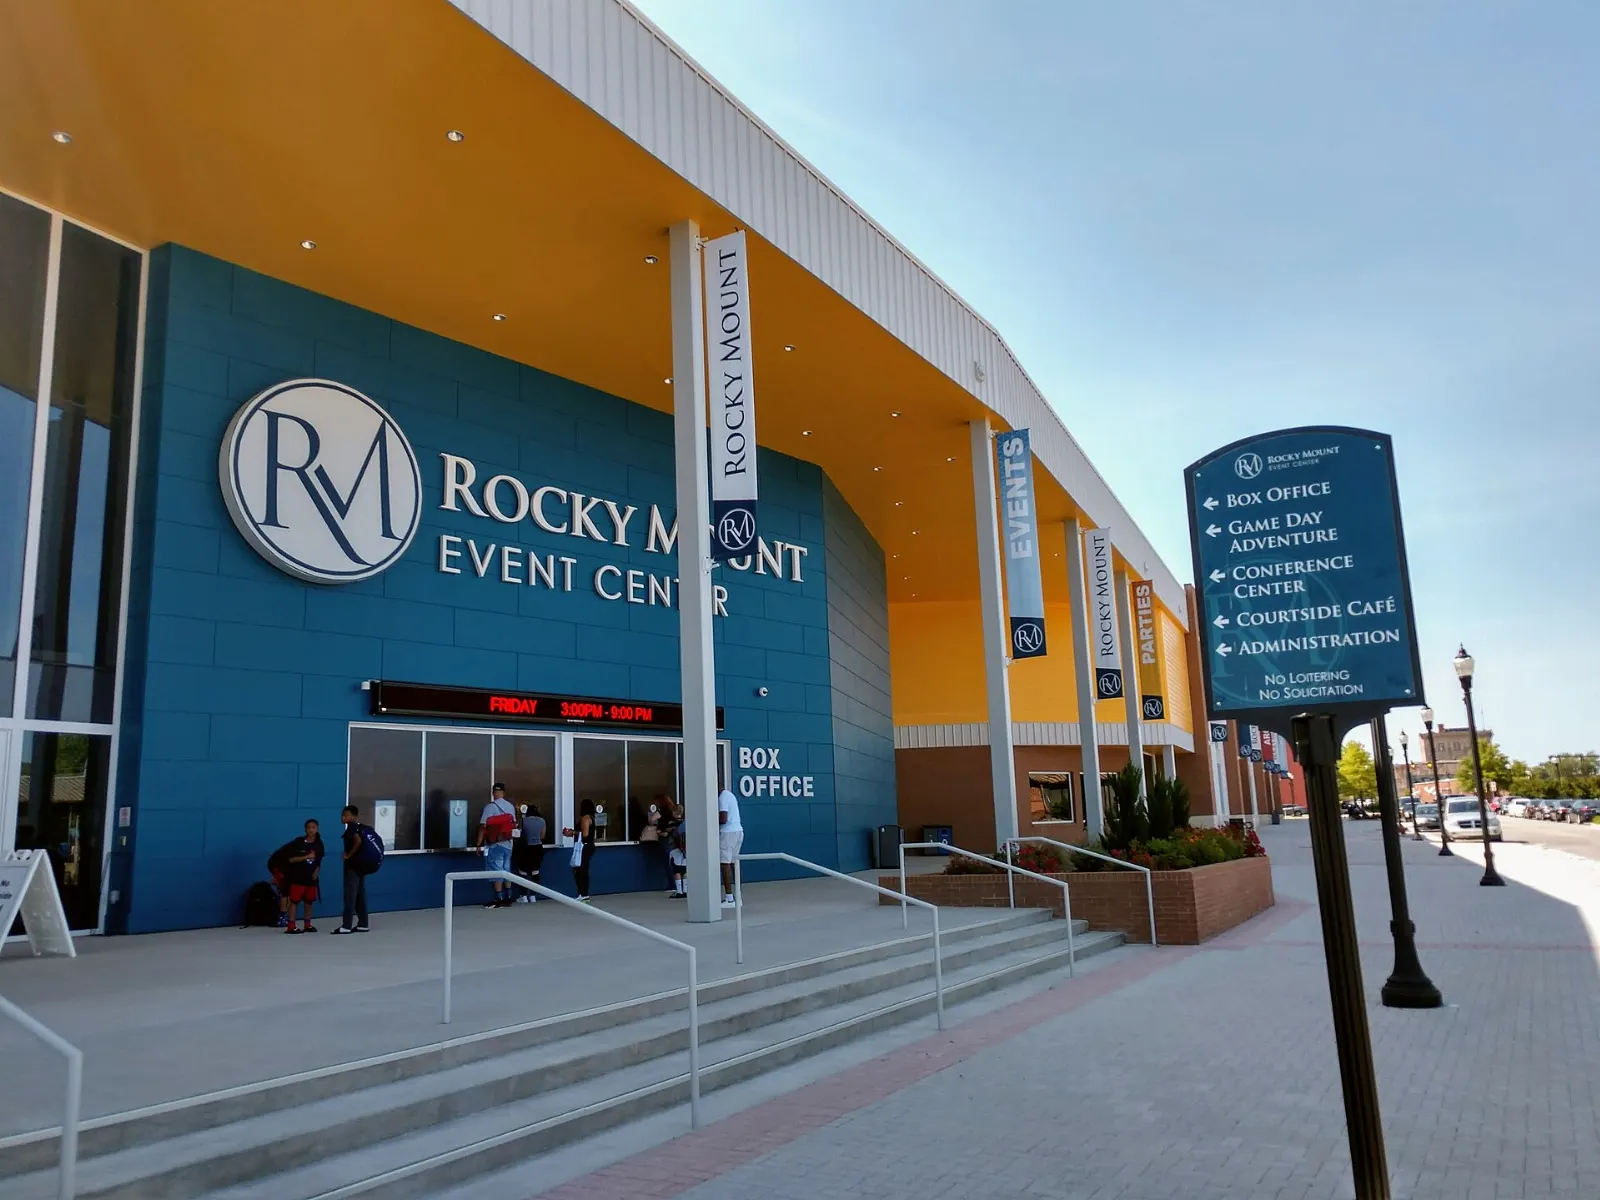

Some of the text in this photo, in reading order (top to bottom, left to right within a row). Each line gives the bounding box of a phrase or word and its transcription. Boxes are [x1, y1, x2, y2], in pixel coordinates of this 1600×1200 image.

[719, 249, 746, 478] ROCKY MOUNT
[1268, 446, 1340, 464] ROCKY MOUNT
[1005, 436, 1032, 560] EVENTS
[1226, 481, 1332, 508] BOX OFFICE
[438, 452, 808, 583] ROCKY MNT
[1228, 511, 1323, 536] GAME DAY
[1229, 528, 1338, 553] ADVENTURE
[439, 534, 729, 617] EVENT CENR
[1232, 555, 1355, 581] CONFERENCE
[1093, 535, 1114, 657] ROCKY MOUNT
[1234, 579, 1306, 599] CENTER
[1135, 583, 1156, 664] PARTIES
[1236, 596, 1397, 628] COURTSIDE CAFÉ
[1239, 628, 1400, 656] ADMINISTRATION
[1289, 670, 1350, 685] LOITERING
[1284, 684, 1363, 699] SOLICITATION
[490, 696, 537, 714] FRIDAY
[739, 747, 780, 769] BOX
[740, 775, 814, 797] OFFICE
